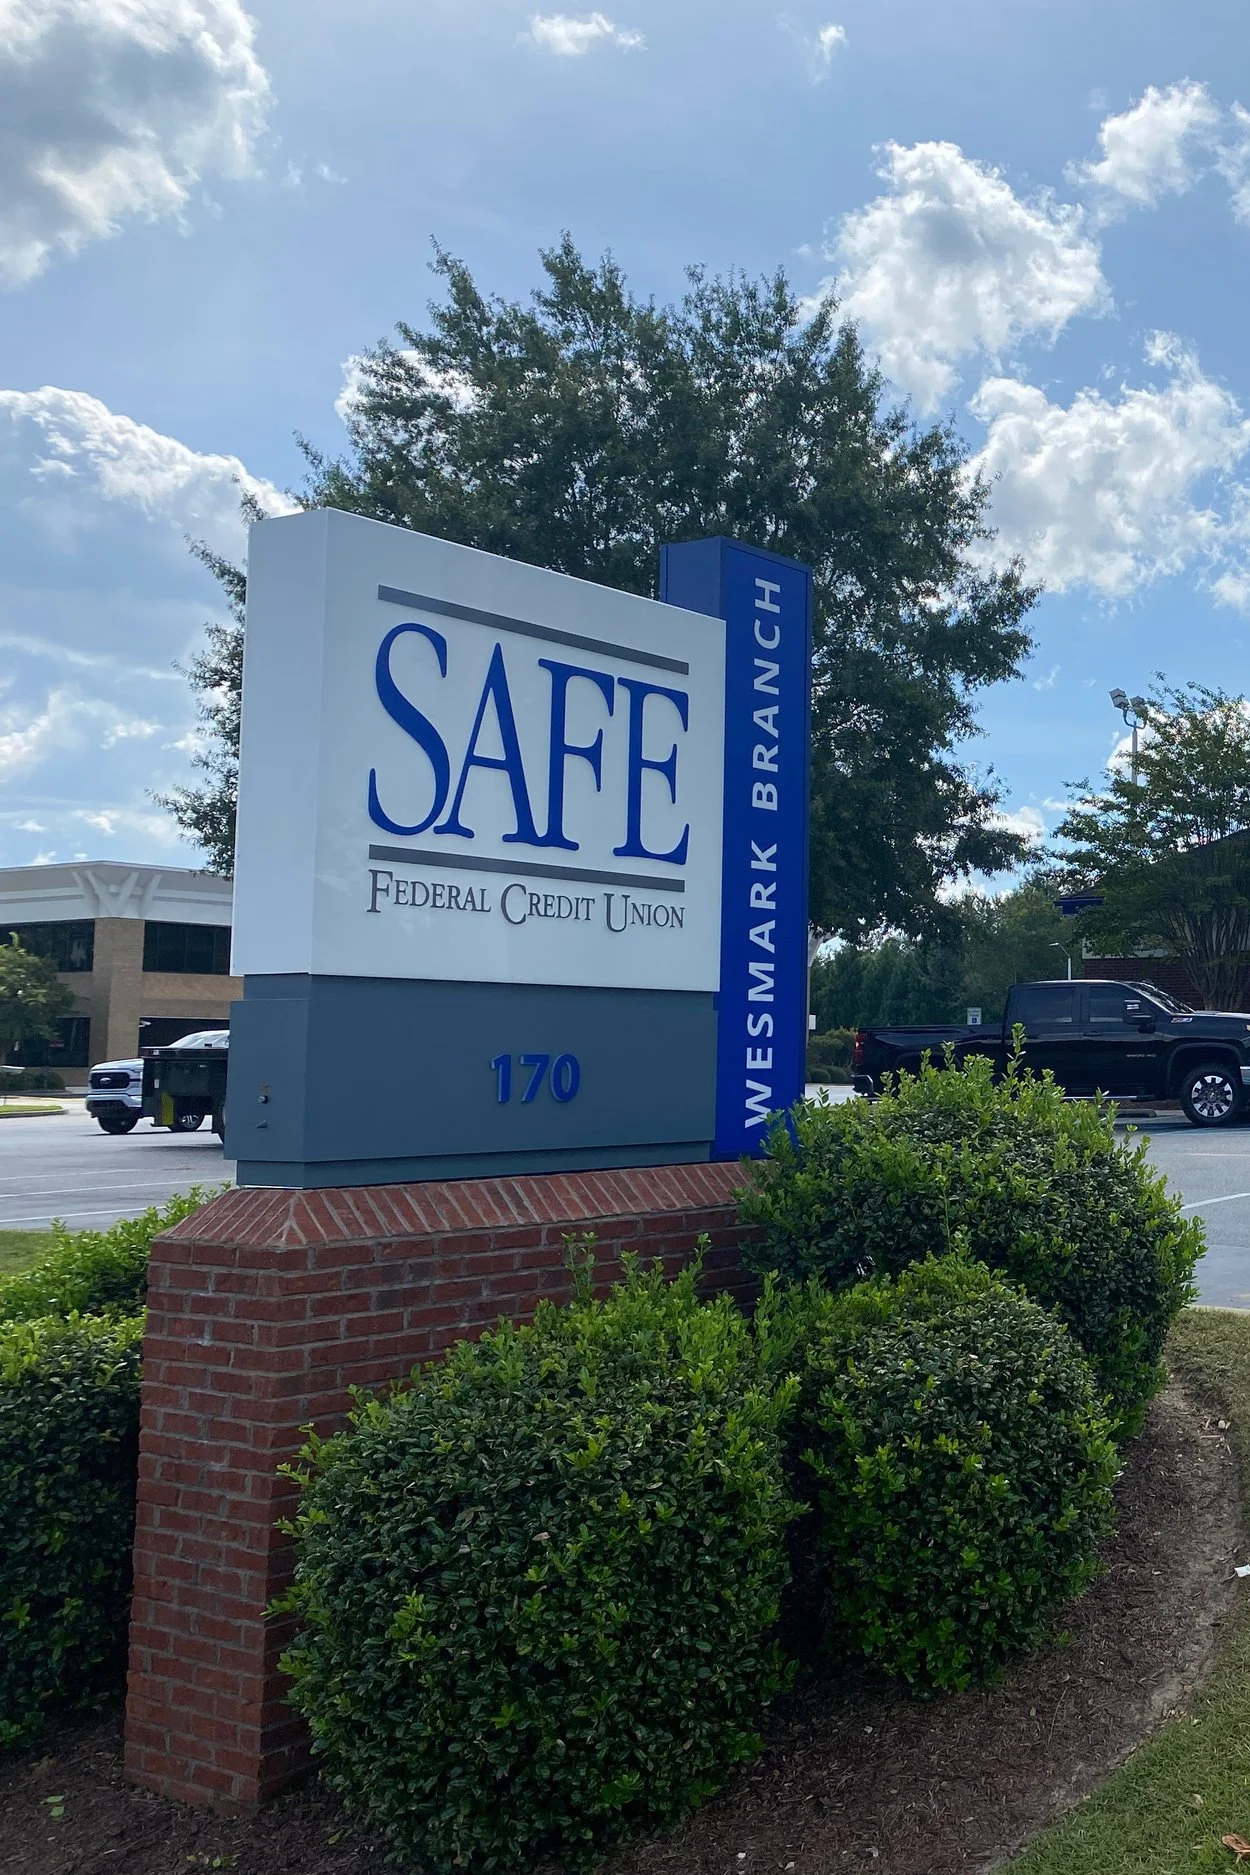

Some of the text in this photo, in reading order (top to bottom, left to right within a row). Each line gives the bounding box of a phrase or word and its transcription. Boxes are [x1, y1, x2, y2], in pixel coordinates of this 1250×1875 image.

[368, 623, 689, 865] SAFE
[367, 869, 685, 932] FEDERAL CREDIT UNION
[745, 578, 781, 1128] WESMARK BRANCH
[490, 1053, 581, 1103] 170
